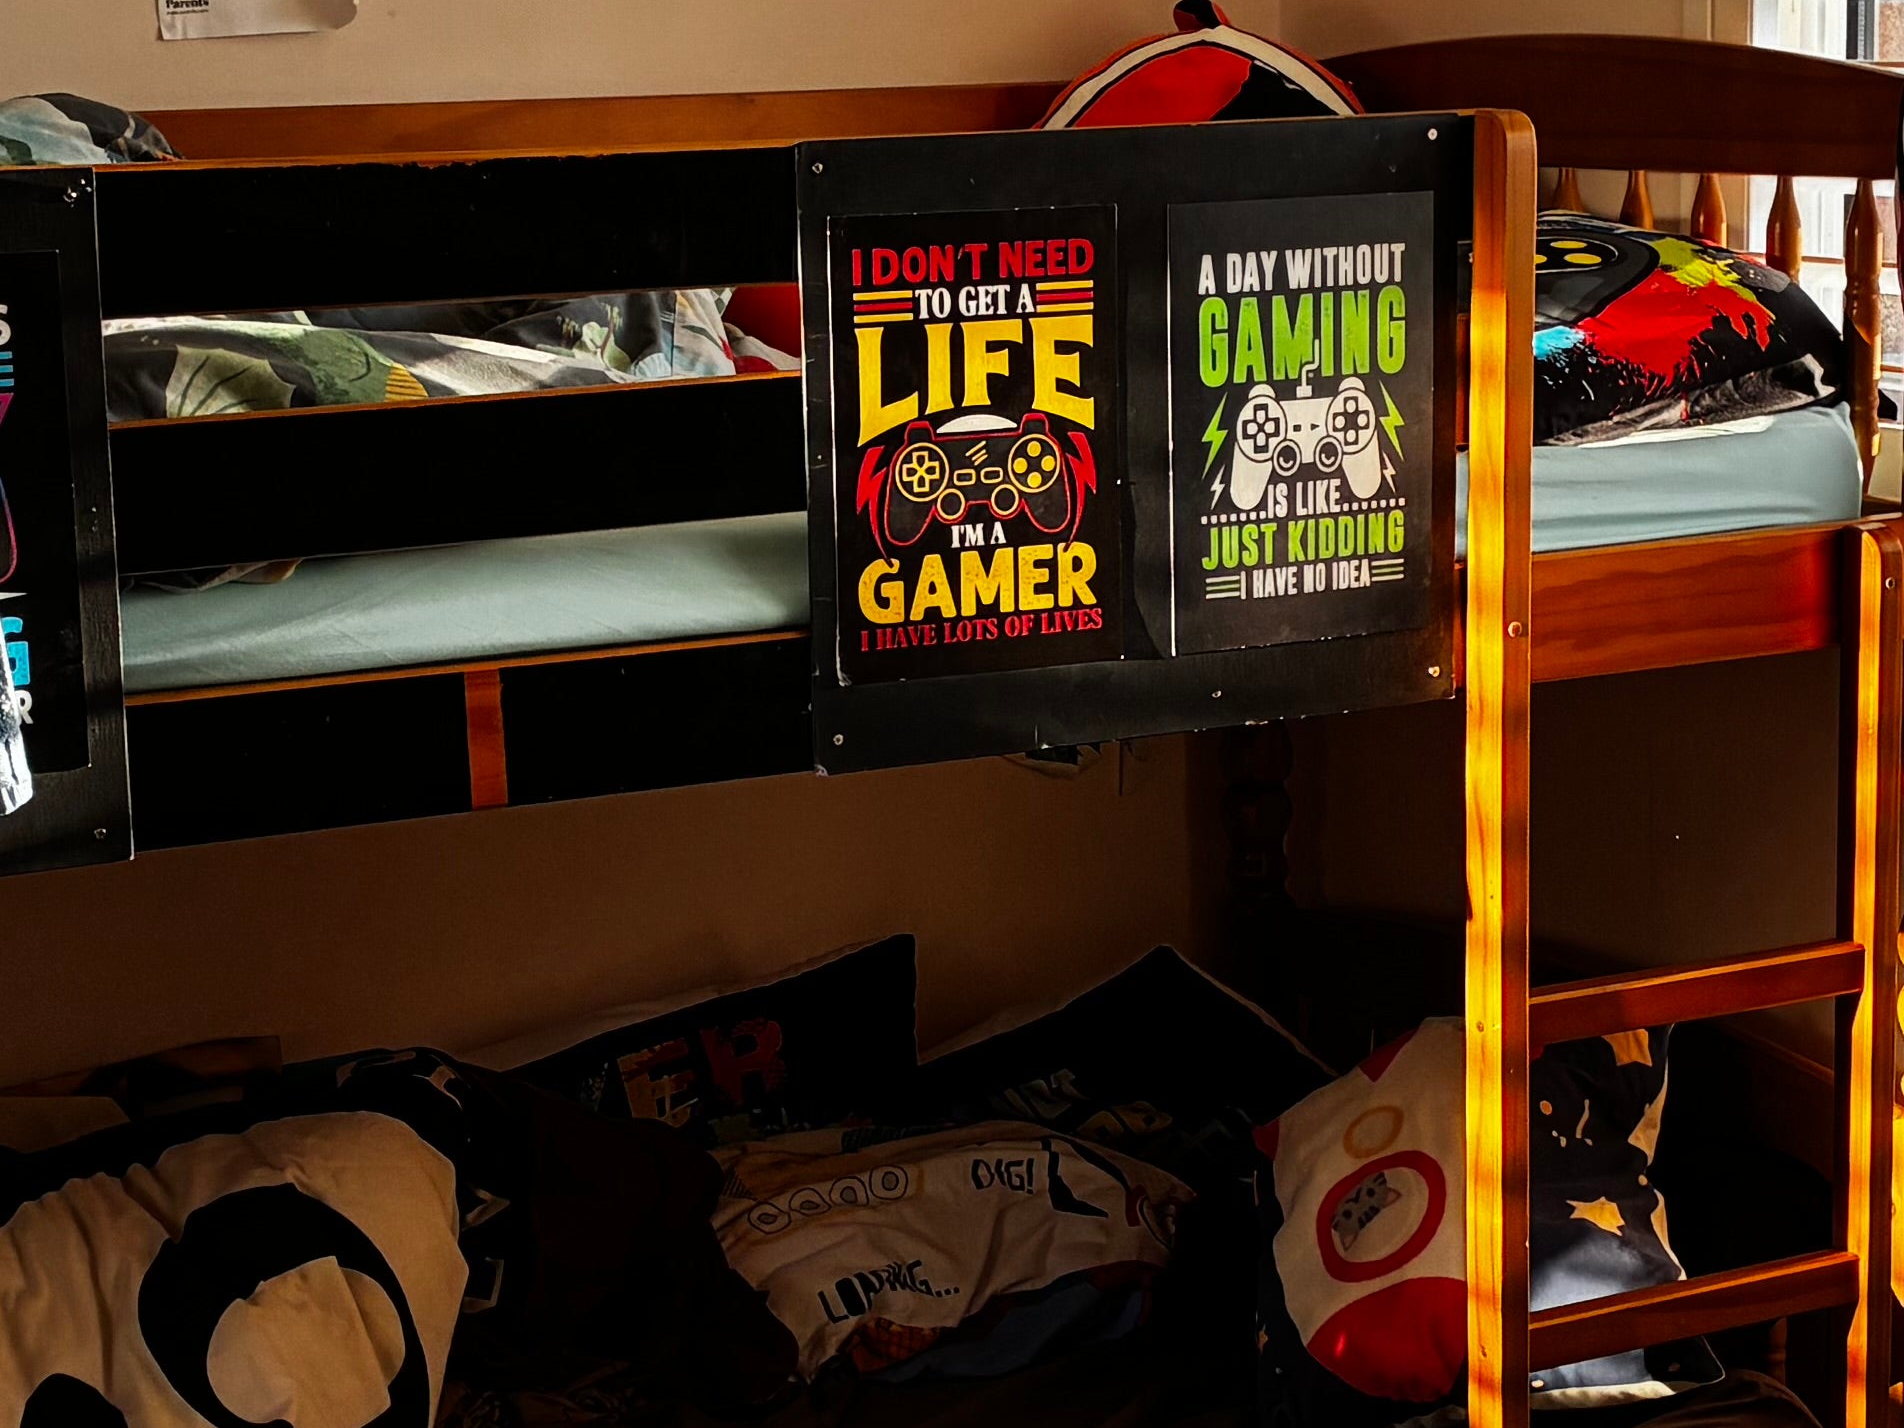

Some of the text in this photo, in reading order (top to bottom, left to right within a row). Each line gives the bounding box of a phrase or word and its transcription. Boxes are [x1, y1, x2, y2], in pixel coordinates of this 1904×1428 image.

[852, 239, 1094, 286] I DON'T NEED
[1198, 243, 1406, 295] A DAY WITHOUT
[915, 283, 1035, 319] TO GET A
[1199, 285, 1406, 388] GAMING
[855, 314, 1095, 448] LIFE
[951, 521, 1007, 548] I'M A
[1202, 509, 1405, 570] JUST KIDDING
[858, 541, 1097, 624] GAMER
[1240, 558, 1372, 600] I HAVE NO IDEA
[861, 608, 1102, 652] I HAVE LOTS OF LIVES
